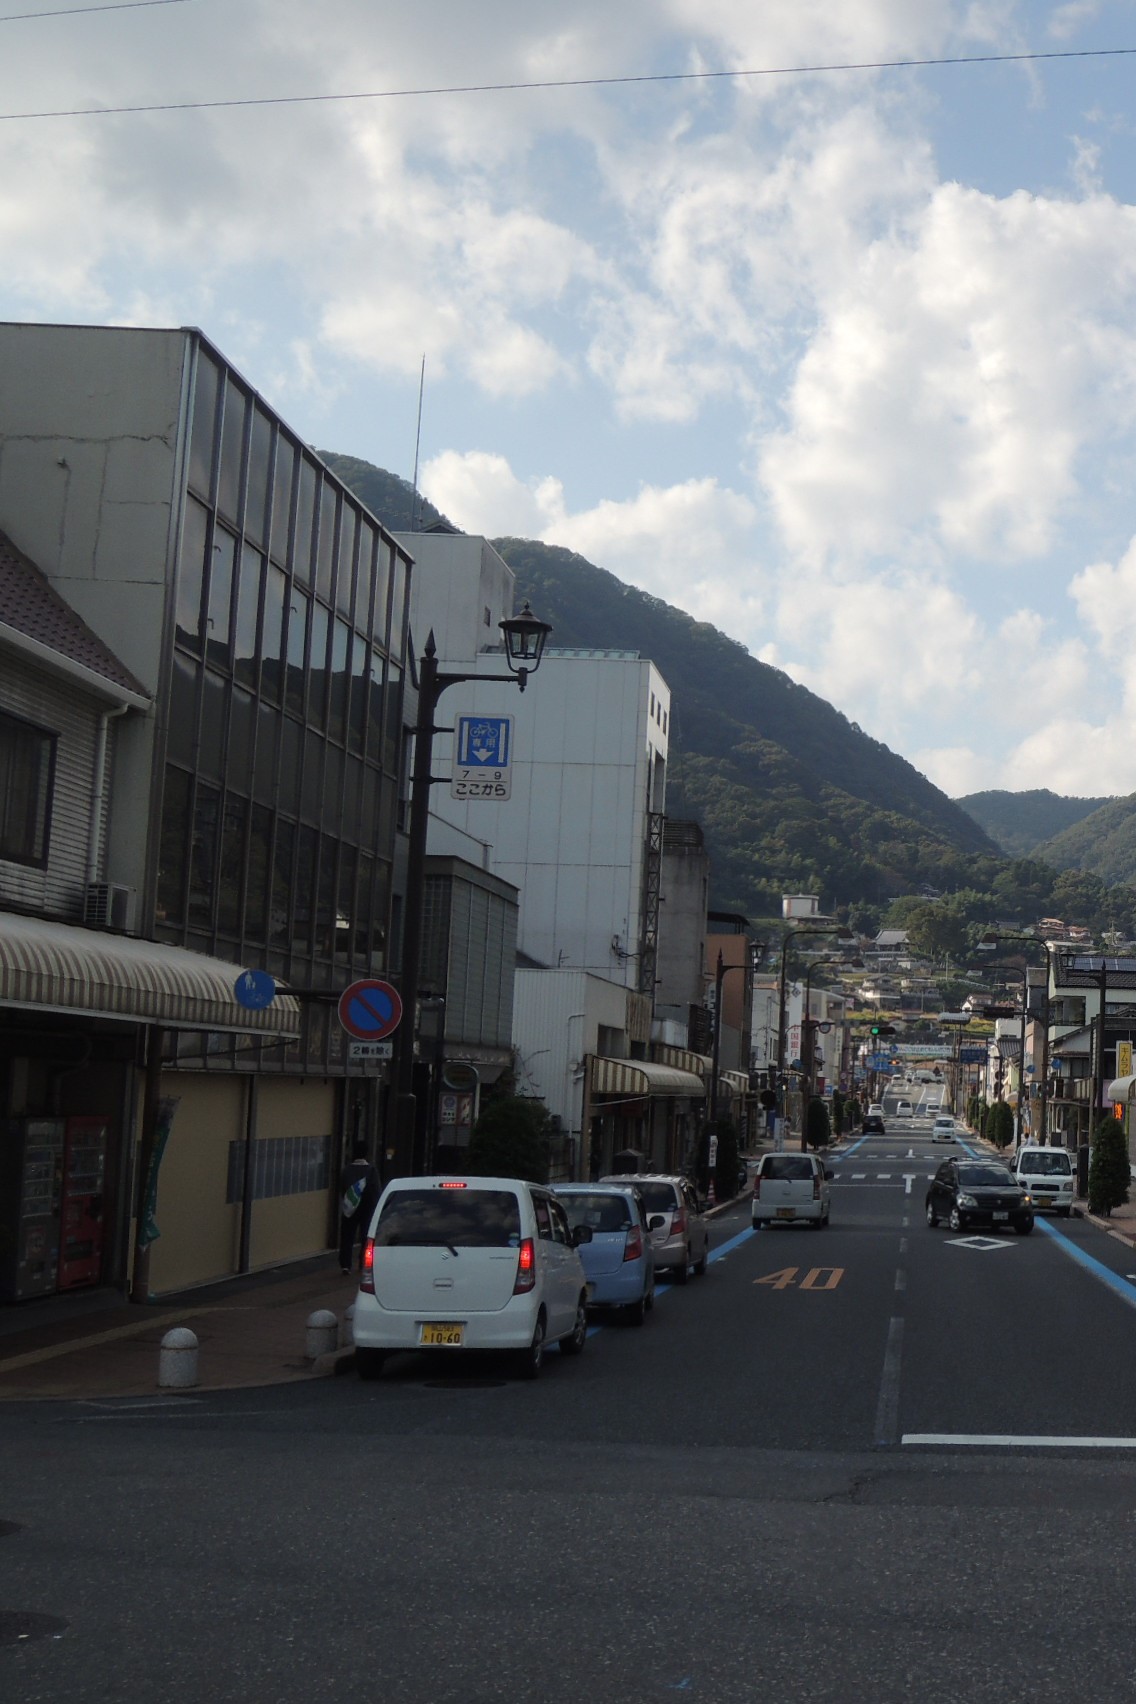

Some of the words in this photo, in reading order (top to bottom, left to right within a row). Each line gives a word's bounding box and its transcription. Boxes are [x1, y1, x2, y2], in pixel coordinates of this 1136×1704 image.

[456, 783, 506, 796] ここから
[1121, 1046, 1129, 1077] キムラヤ
[752, 1266, 845, 1289] 40
